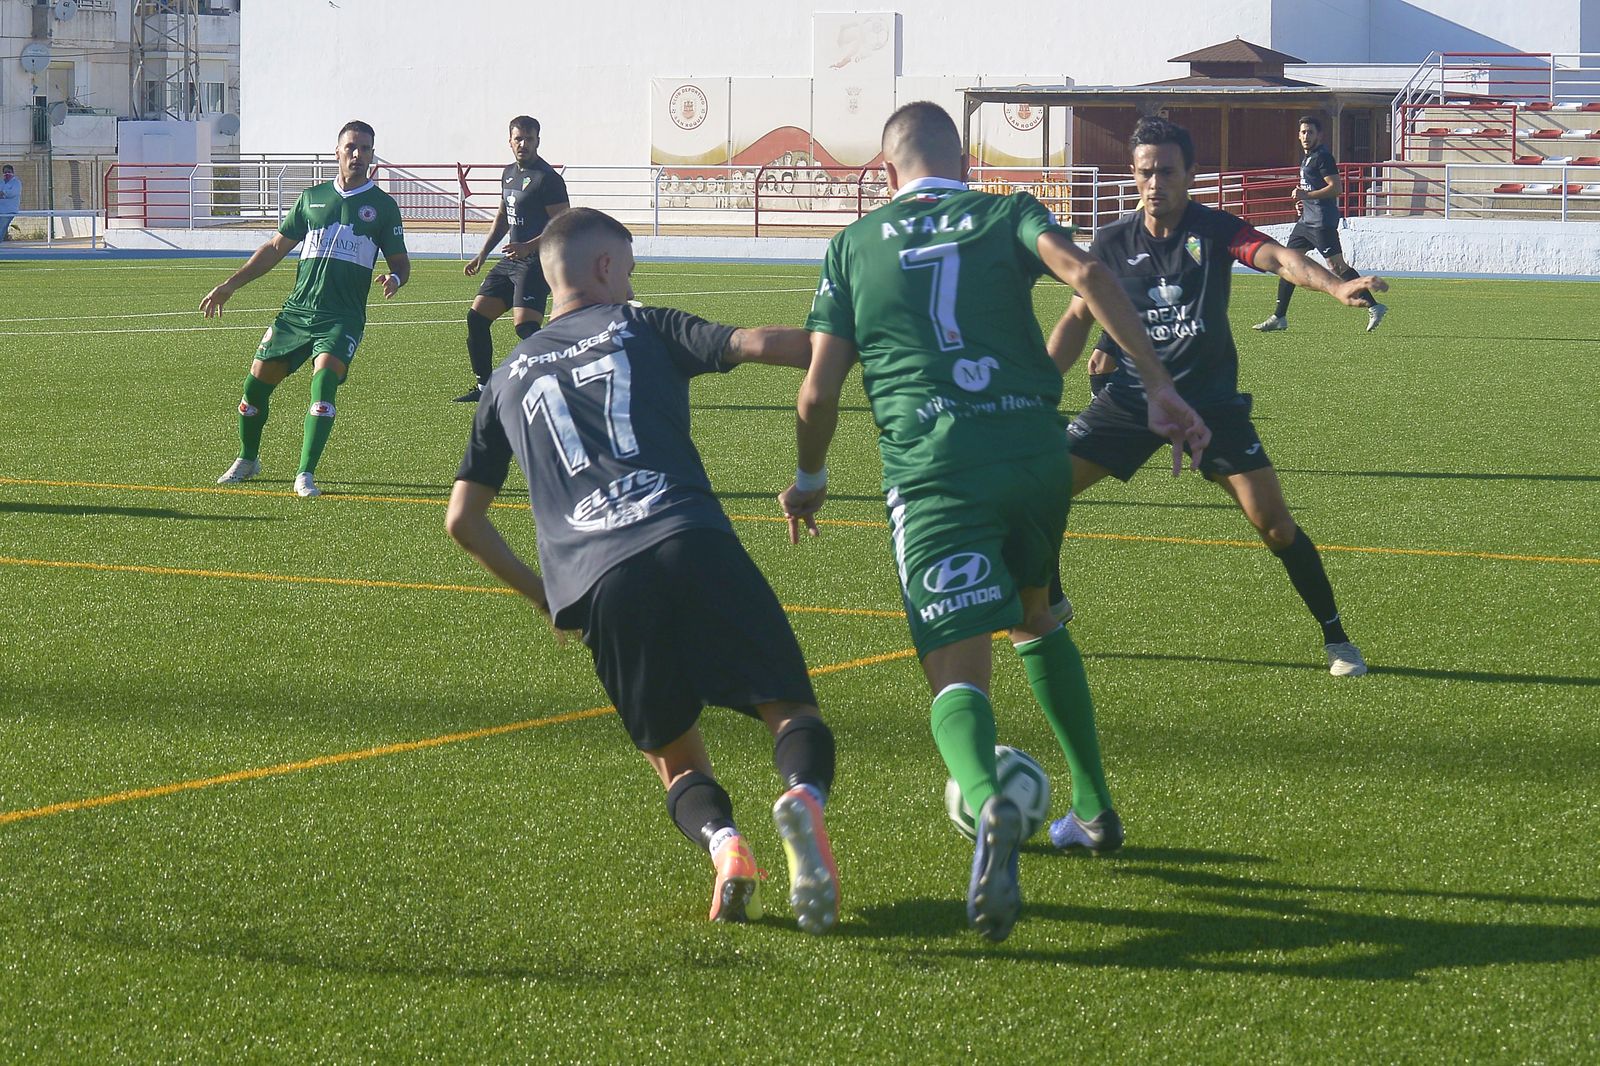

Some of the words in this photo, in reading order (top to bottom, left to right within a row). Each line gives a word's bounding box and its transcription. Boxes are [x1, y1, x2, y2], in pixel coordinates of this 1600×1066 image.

[1008, 115, 1020, 127] SAN
[1020, 116, 1040, 129] ROQUE
[880, 213, 974, 240] AYALA
[898, 242, 964, 352] 7
[1147, 305, 1191, 324] REAL
[527, 331, 611, 367] PRIVILEGE
[963, 365, 983, 384] M
[522, 350, 641, 477] 17
[920, 585, 1002, 623] HYUNDAI
